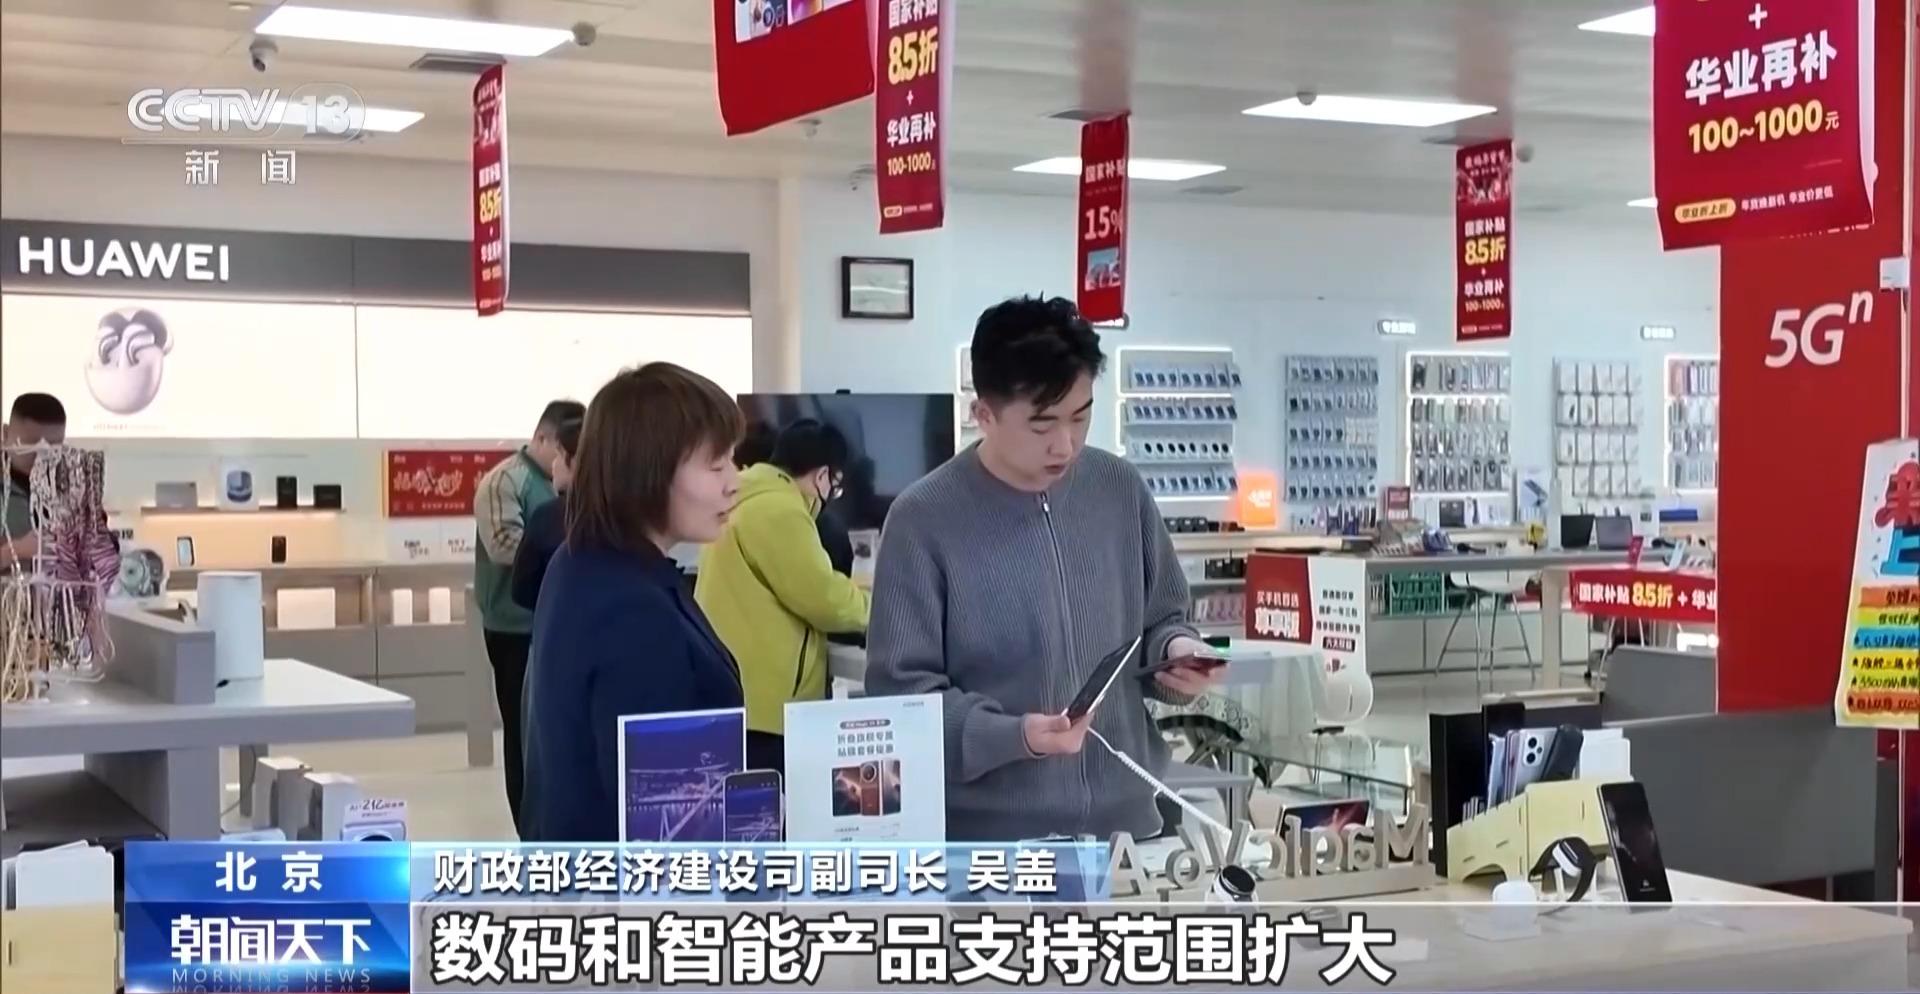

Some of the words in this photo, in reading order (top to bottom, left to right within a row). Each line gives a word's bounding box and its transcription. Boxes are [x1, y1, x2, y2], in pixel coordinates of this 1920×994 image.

[888, 26, 938, 85] 8.5折
[1685, 29, 1837, 105] 华业再补
[887, 111, 936, 148] 华业再补
[1688, 99, 1839, 153] 100~1000元
[19, 236, 229, 282] HUAWEI
[1579, 582, 1630, 605] 国家补贴
[1632, 581, 1673, 608] 8.5折
